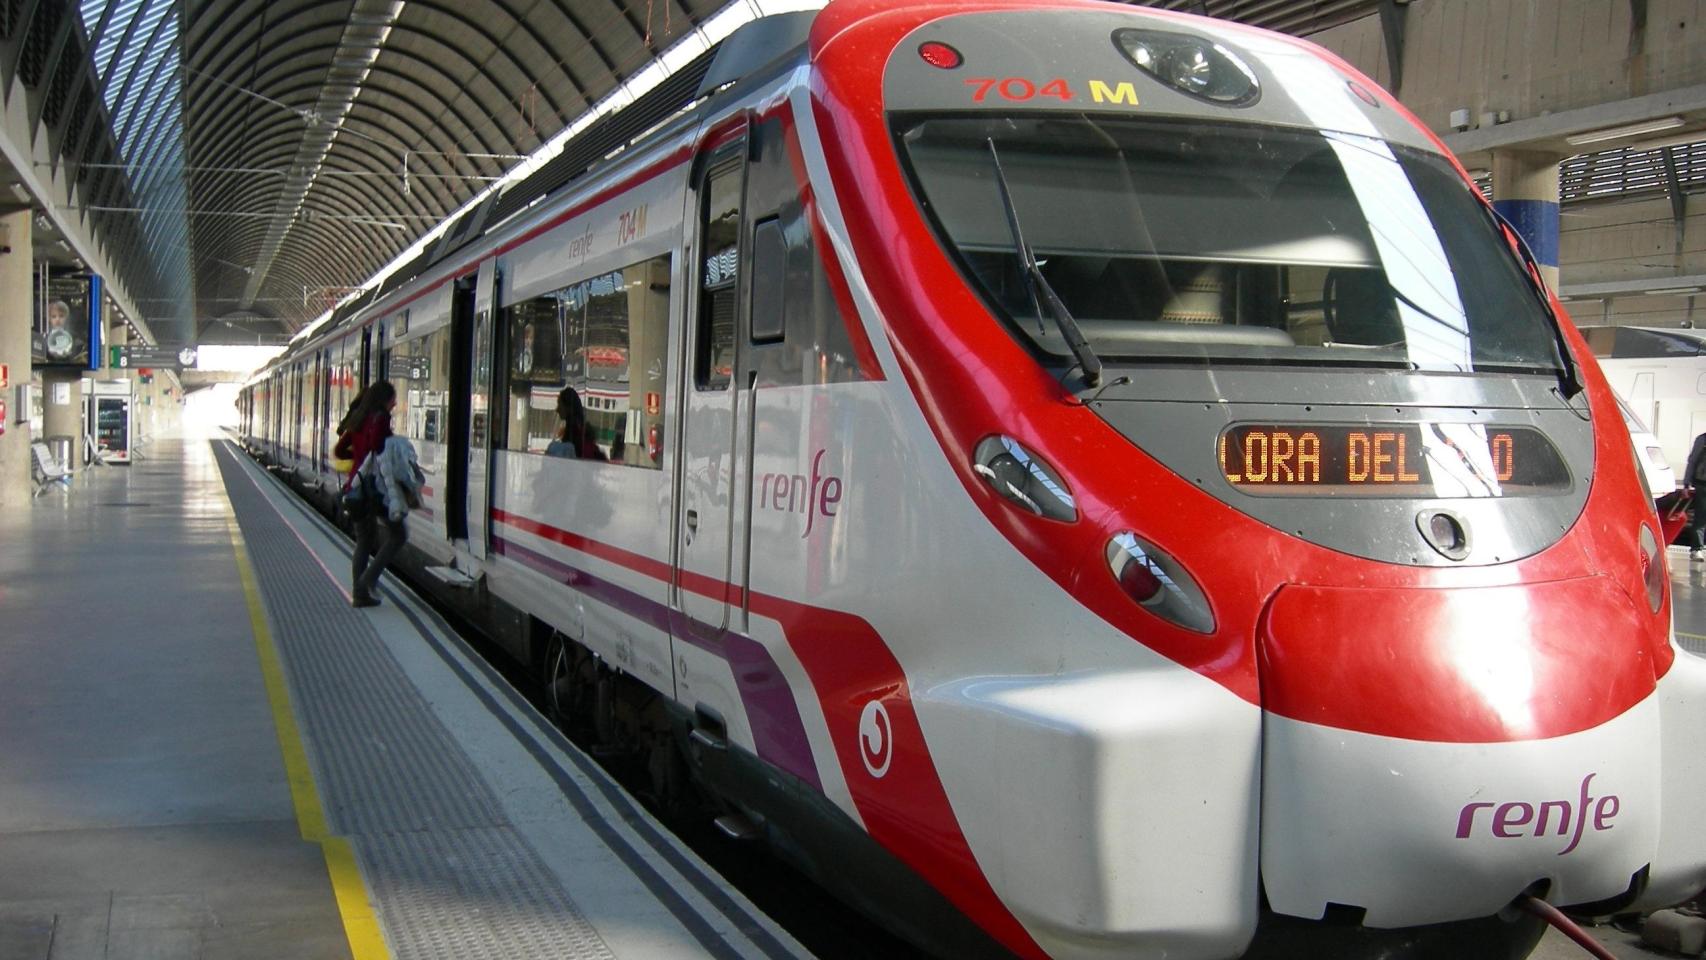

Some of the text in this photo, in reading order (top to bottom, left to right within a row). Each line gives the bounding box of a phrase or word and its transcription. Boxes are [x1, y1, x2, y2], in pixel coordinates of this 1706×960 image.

[963, 77, 1140, 106] 704 M
[568, 222, 594, 267] renfe
[120, 356, 128, 367] 8
[1220, 431, 1321, 483] LORA
[1349, 432, 1420, 482] DEL
[760, 448, 843, 539] renfe
[1455, 772, 1621, 856] renfe
